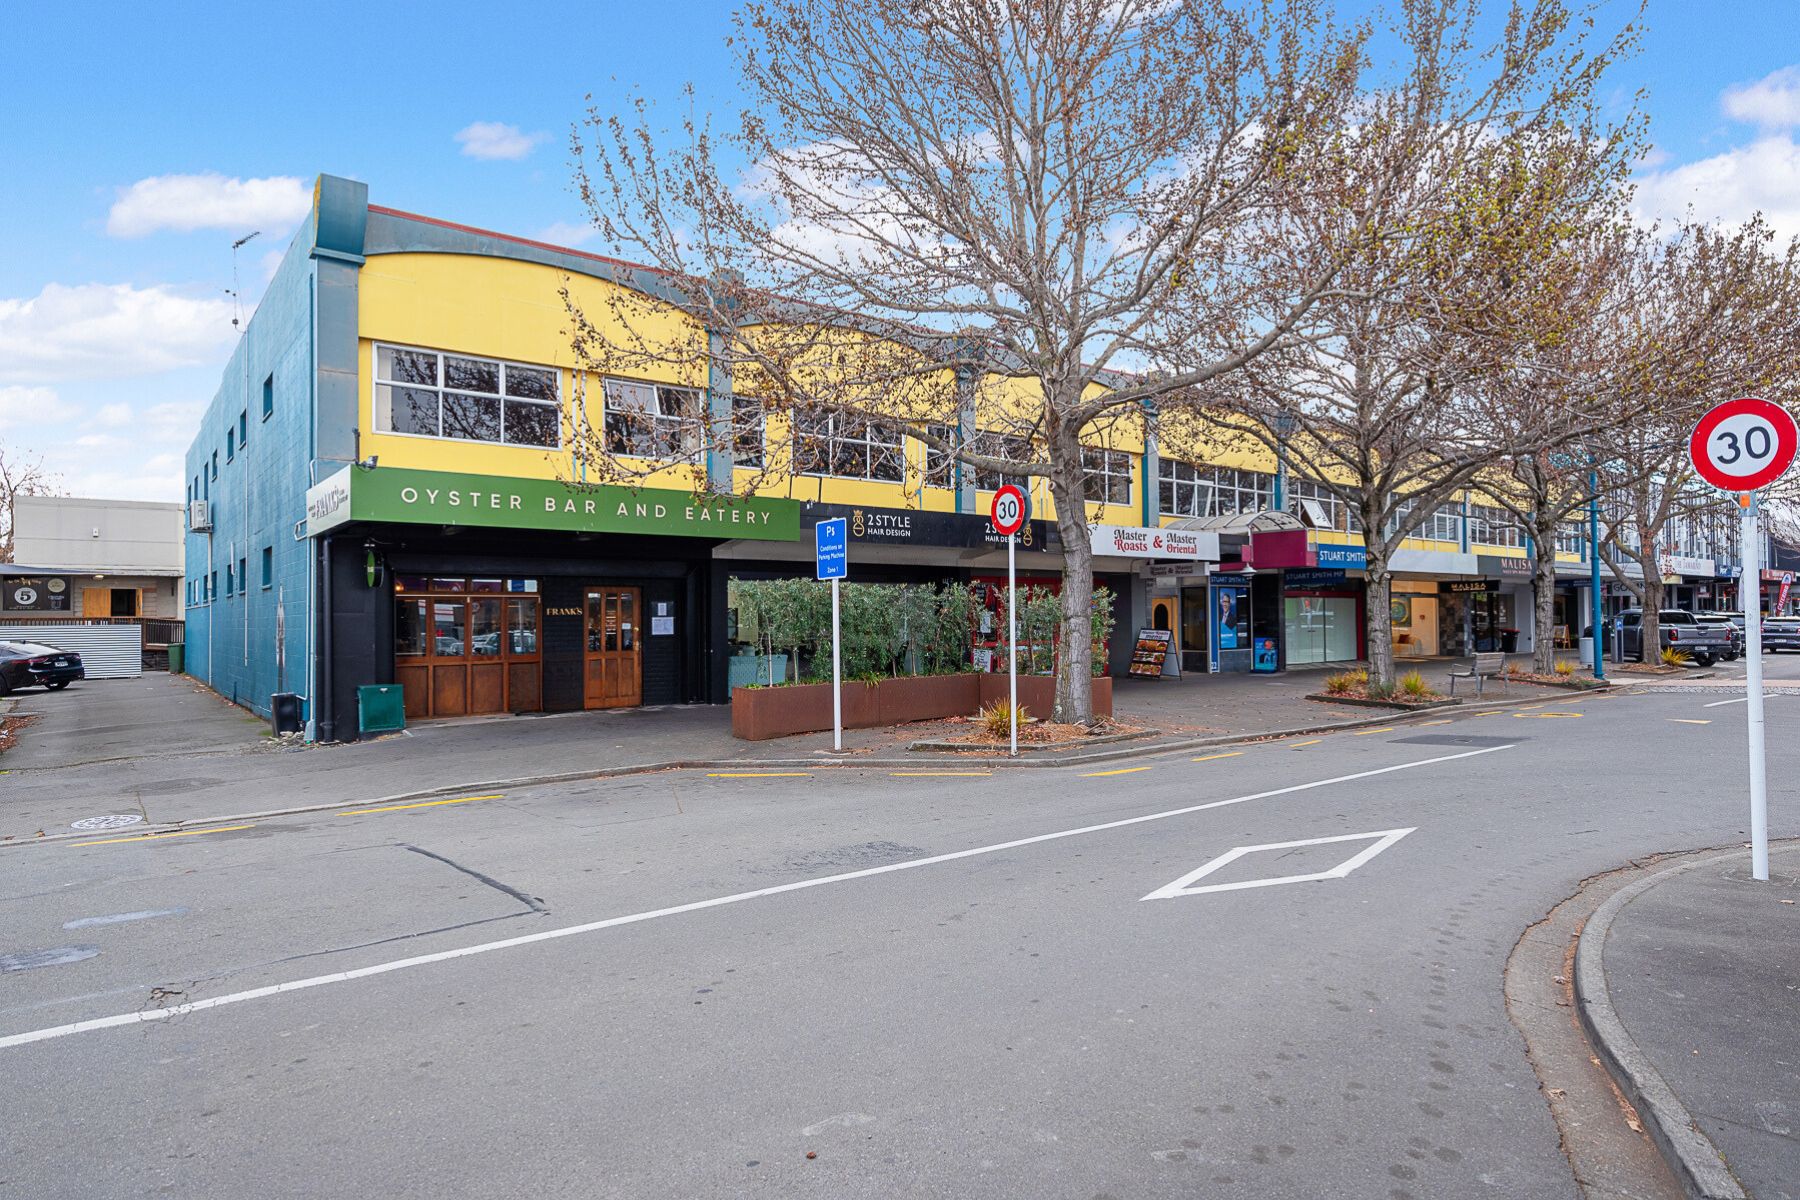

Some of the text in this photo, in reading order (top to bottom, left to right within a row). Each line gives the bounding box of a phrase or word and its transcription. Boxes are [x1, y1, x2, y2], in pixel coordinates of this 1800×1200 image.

[1717, 426, 1771, 464] 30
[401, 488, 770, 524] OYSTER BAR AND EATERY
[998, 500, 1016, 519] 30
[886, 529, 910, 537] DESIGN
[1114, 529, 1147, 541] Master
[1166, 532, 1196, 544] Master
[1114, 539, 1148, 552] Roasts
[1153, 536, 1162, 548] &
[1166, 544, 1197, 554] Oriental
[1320, 550, 1366, 562] STUART SMITH
[1502, 558, 1532, 570] MALISA
[20, 591, 32, 602] 5
[546, 607, 583, 616] FRANK'S
